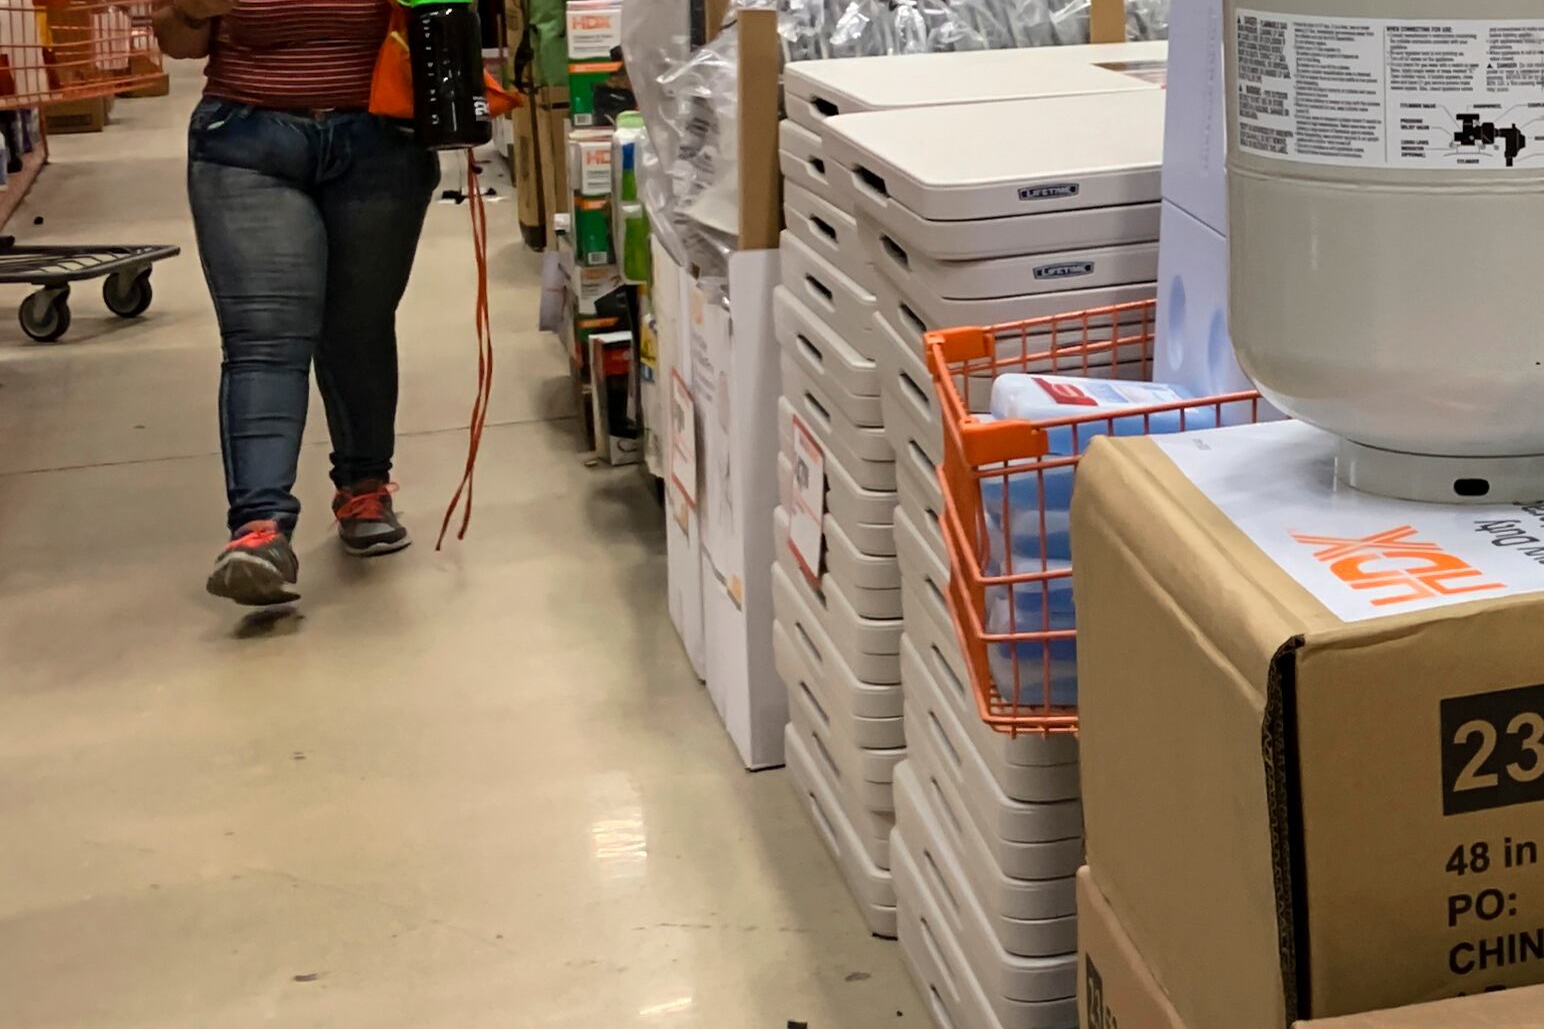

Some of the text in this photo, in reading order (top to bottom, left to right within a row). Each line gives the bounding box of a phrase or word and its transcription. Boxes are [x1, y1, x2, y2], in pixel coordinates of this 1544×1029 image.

[1473, 519, 1542, 548] Duty
[1289, 525, 1507, 608] HDX
[1445, 841, 1490, 876] 48
[1504, 837, 1537, 868] in
[1448, 888, 1518, 927] PO:
